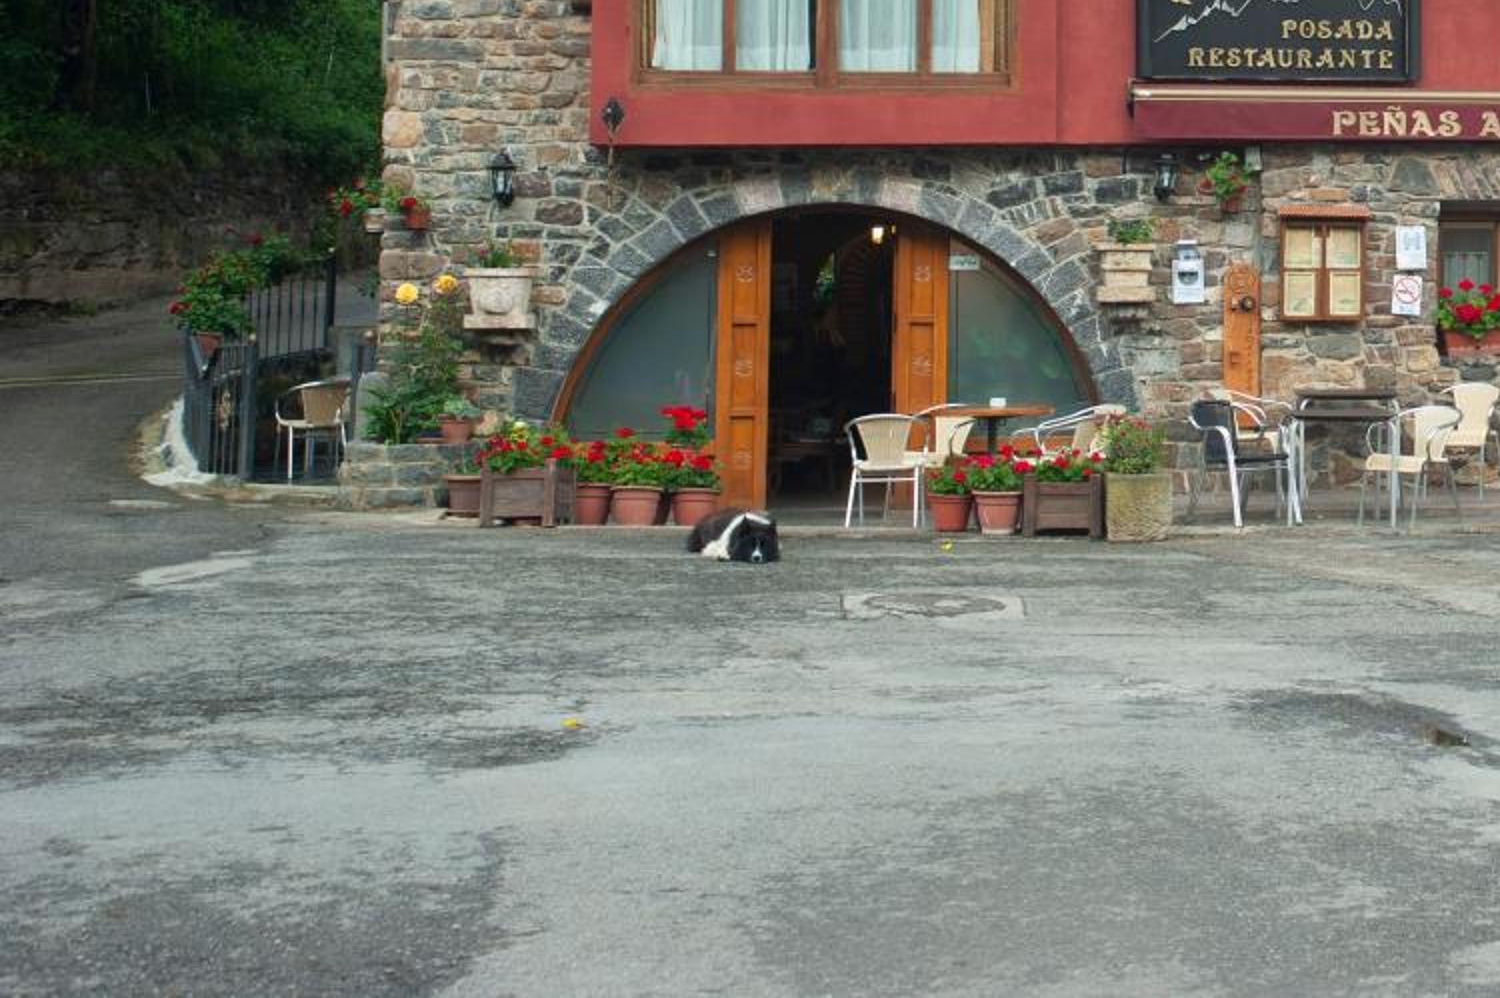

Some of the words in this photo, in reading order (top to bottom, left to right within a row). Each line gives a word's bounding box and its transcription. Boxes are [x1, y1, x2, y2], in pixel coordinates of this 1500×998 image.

[1281, 19, 1394, 40] POSADA
[1187, 47, 1394, 69] RESTAURANTE
[1331, 106, 1462, 138] PEÑAS
